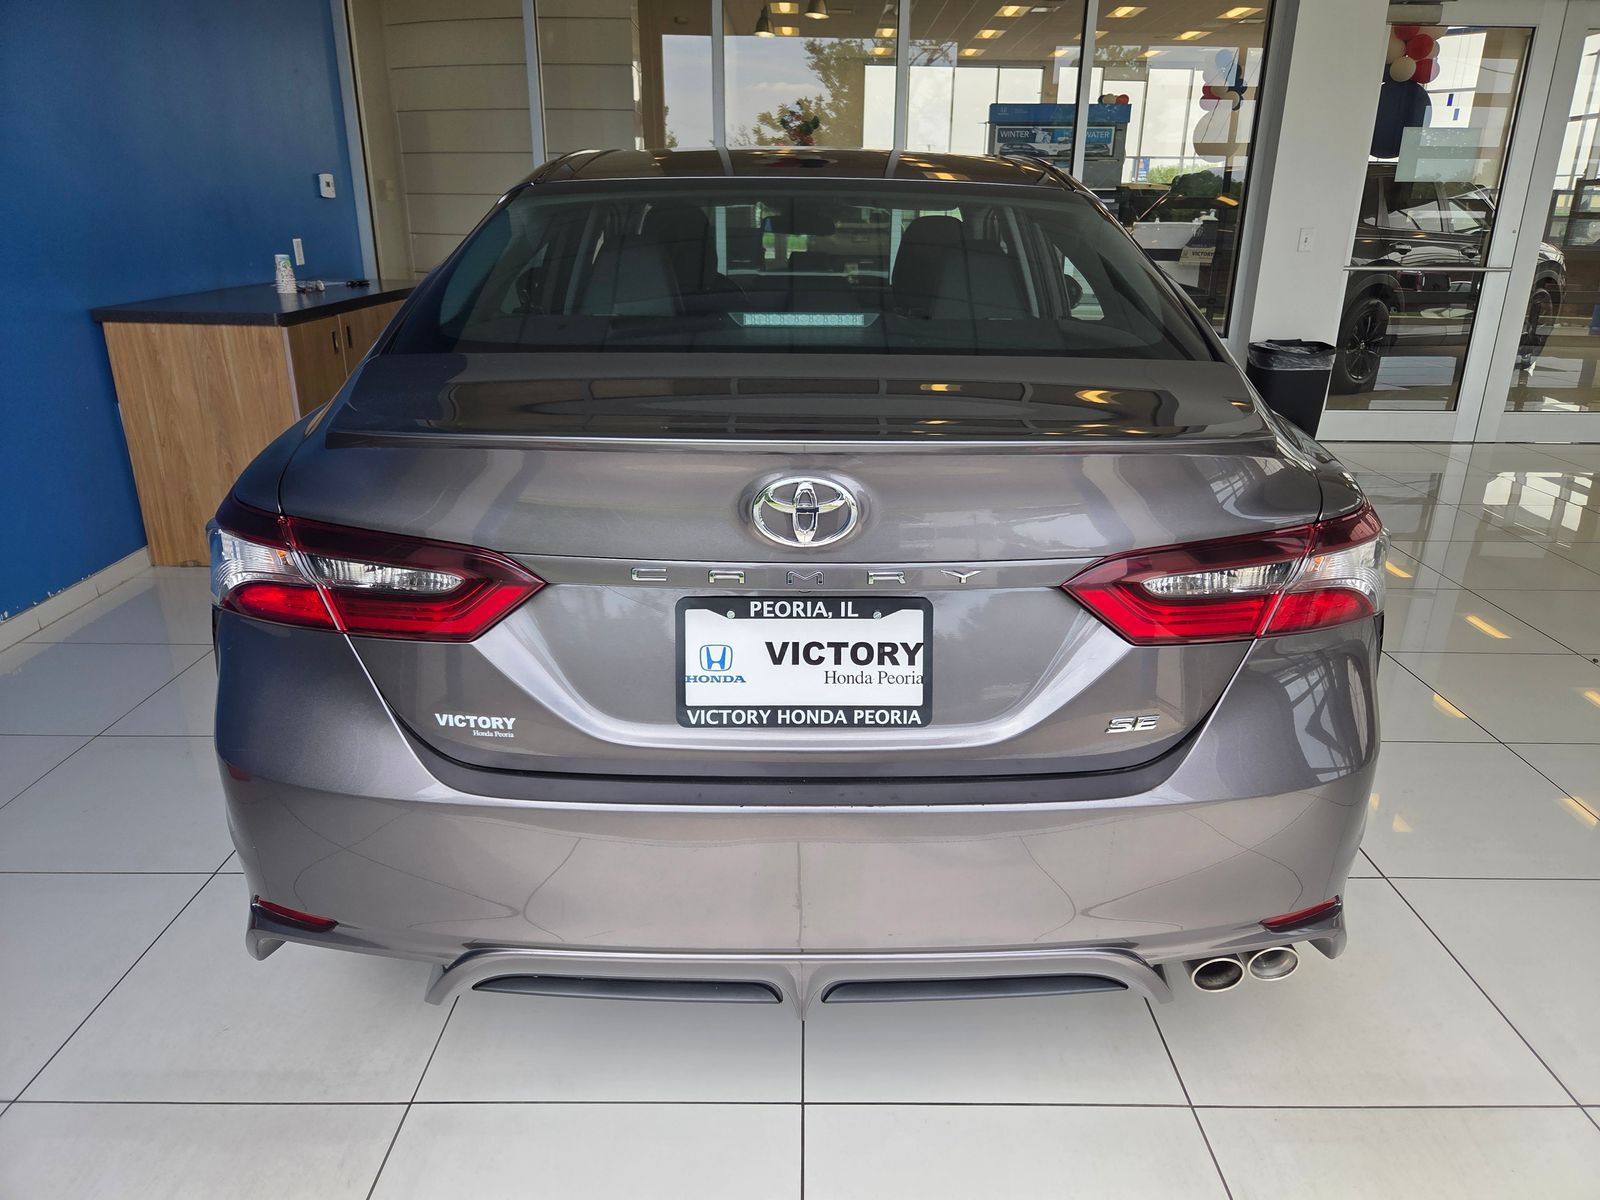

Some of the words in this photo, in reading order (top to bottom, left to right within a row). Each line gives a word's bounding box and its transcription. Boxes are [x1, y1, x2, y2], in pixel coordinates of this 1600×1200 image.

[1000, 130, 1030, 138] WINTER
[631, 566, 983, 585] CAMRY
[750, 601, 833, 618] PEORIA,
[840, 601, 859, 618] IL
[765, 641, 924, 666] VICTORY
[685, 674, 747, 684] HONDA
[823, 671, 873, 685] Honda
[877, 671, 924, 685] Peoria
[434, 713, 516, 730] VICTORY
[687, 709, 771, 725] VICTORY
[777, 709, 847, 725] HONDA
[853, 709, 922, 725] PEORIA
[1104, 714, 1160, 734] SE
